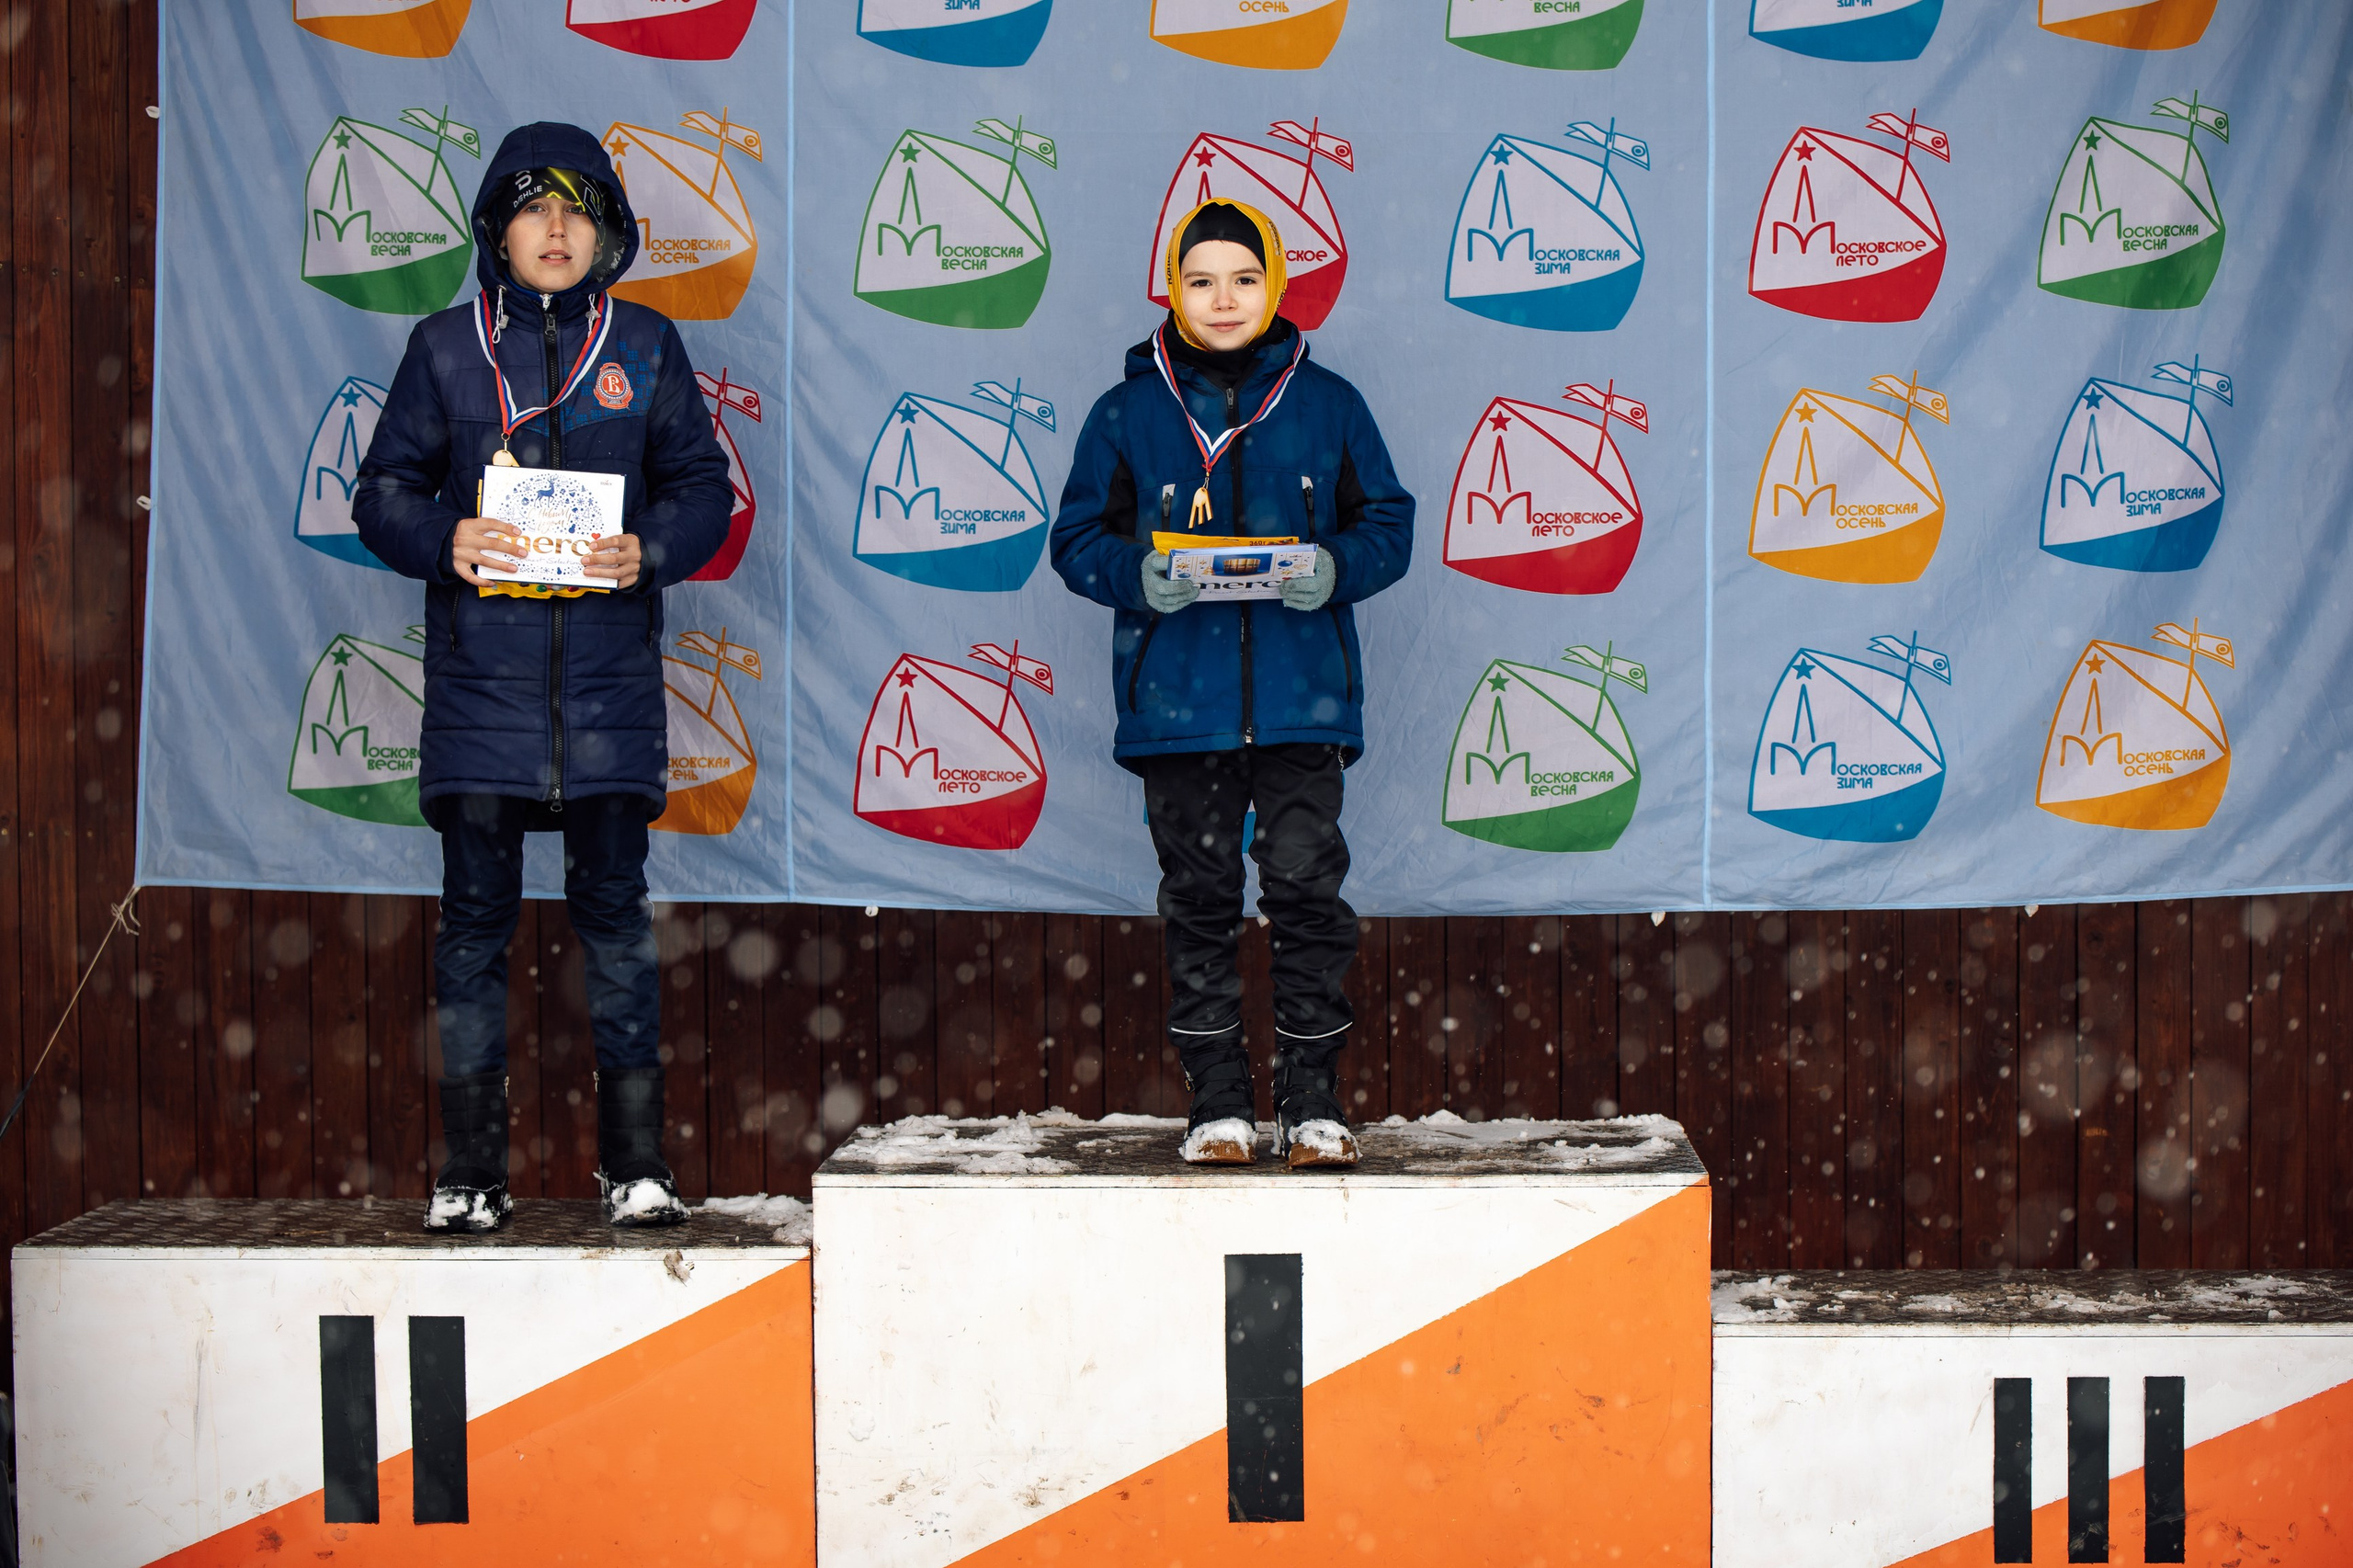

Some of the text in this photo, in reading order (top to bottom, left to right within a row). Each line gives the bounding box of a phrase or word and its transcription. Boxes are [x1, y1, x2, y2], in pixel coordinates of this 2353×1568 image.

[636, 217, 731, 251] ОСКОВСКАЯ
[497, 532, 601, 557] merc
[1197, 576, 1292, 595] merc
